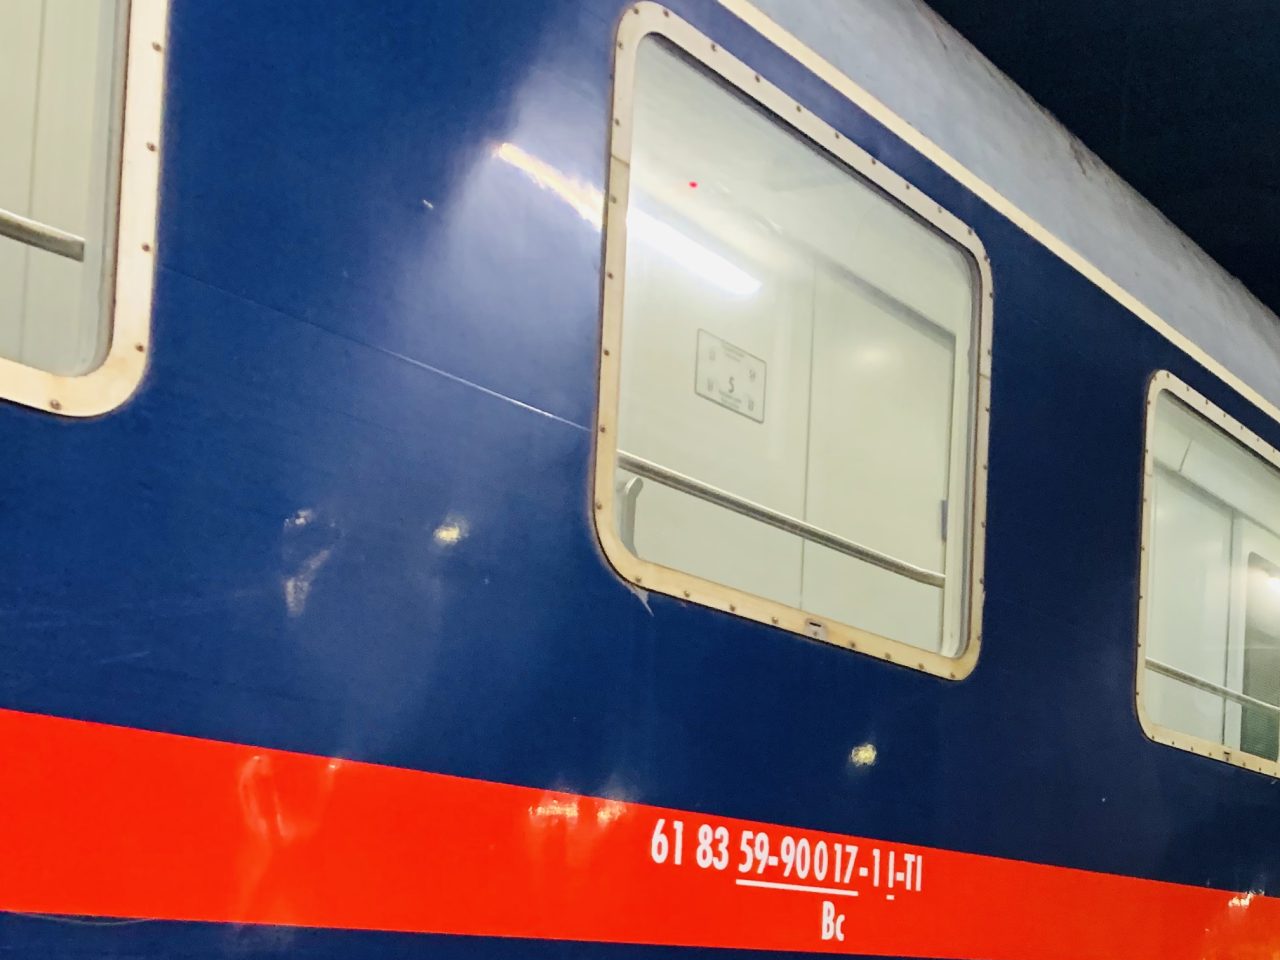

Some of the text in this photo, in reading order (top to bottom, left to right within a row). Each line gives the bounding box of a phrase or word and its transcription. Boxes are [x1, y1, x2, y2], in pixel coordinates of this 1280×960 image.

[651, 818, 684, 865] 61
[696, 824, 729, 870] 83
[821, 900, 845, 941] Bc
